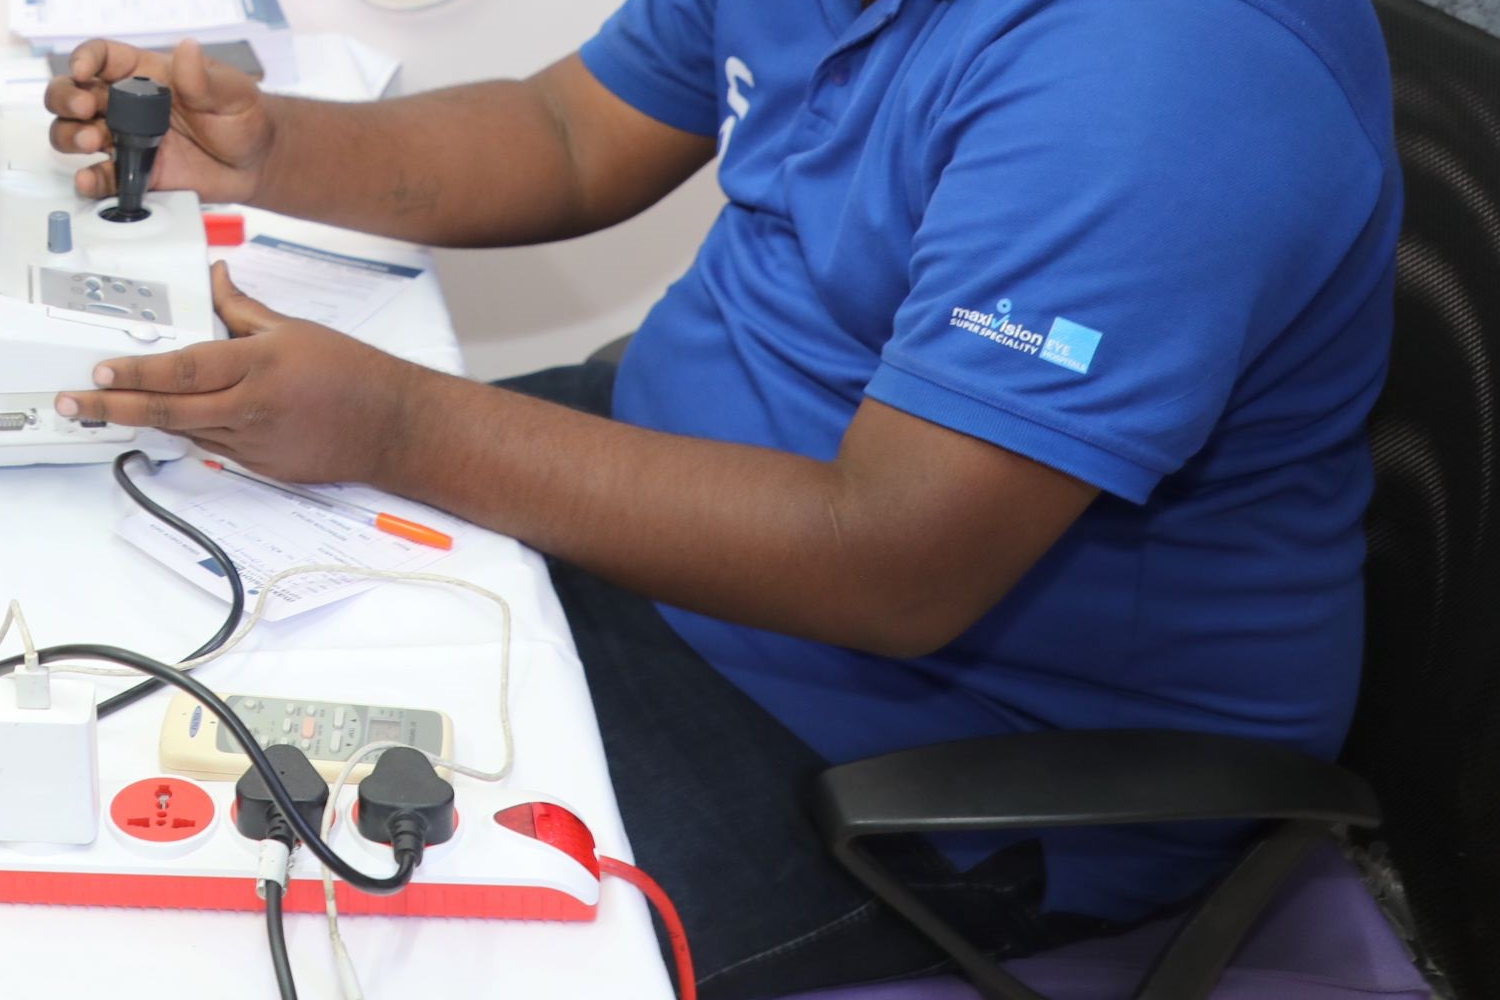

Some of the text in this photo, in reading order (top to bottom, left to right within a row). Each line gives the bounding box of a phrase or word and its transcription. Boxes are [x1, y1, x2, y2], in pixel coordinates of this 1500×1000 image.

[949, 317, 1040, 356] SUPER SPECIALITY
[951, 305, 1044, 346] maxivision
[1046, 339, 1072, 356] EYE
